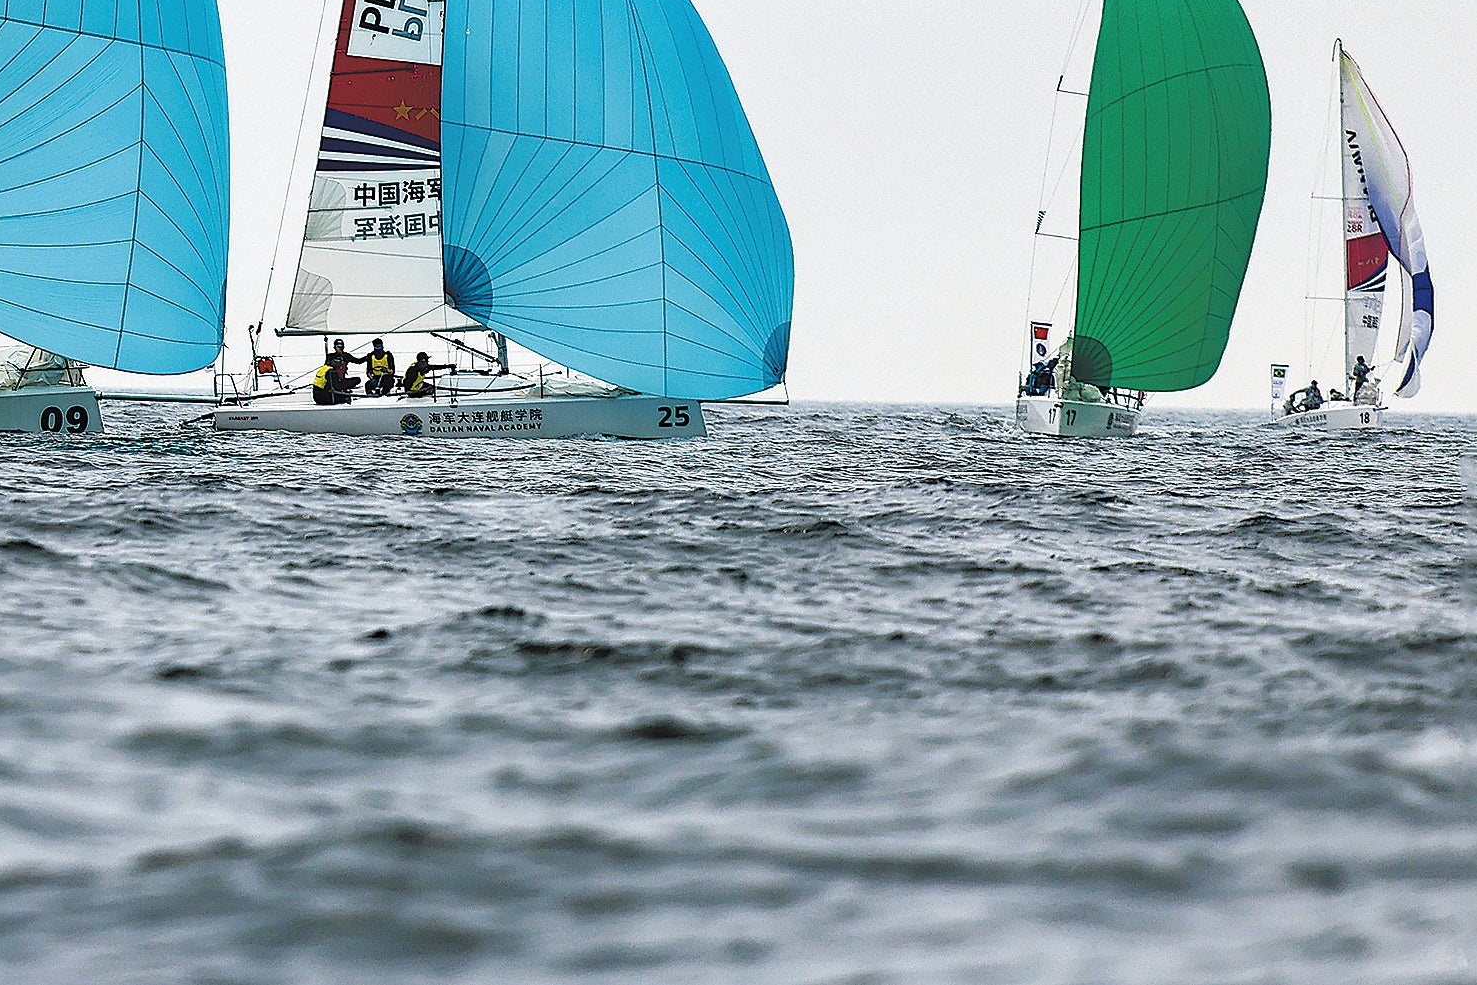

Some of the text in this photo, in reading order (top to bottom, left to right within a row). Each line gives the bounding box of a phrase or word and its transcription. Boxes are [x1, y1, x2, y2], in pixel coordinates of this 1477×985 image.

[40, 405, 89, 434] 09
[428, 408, 543, 425] 海军大连舰艇学院
[657, 405, 690, 428] 25
[1066, 409, 1077, 426] 17
[1359, 411, 1370, 424] 18
[498, 423, 542, 431] ACADEMY
